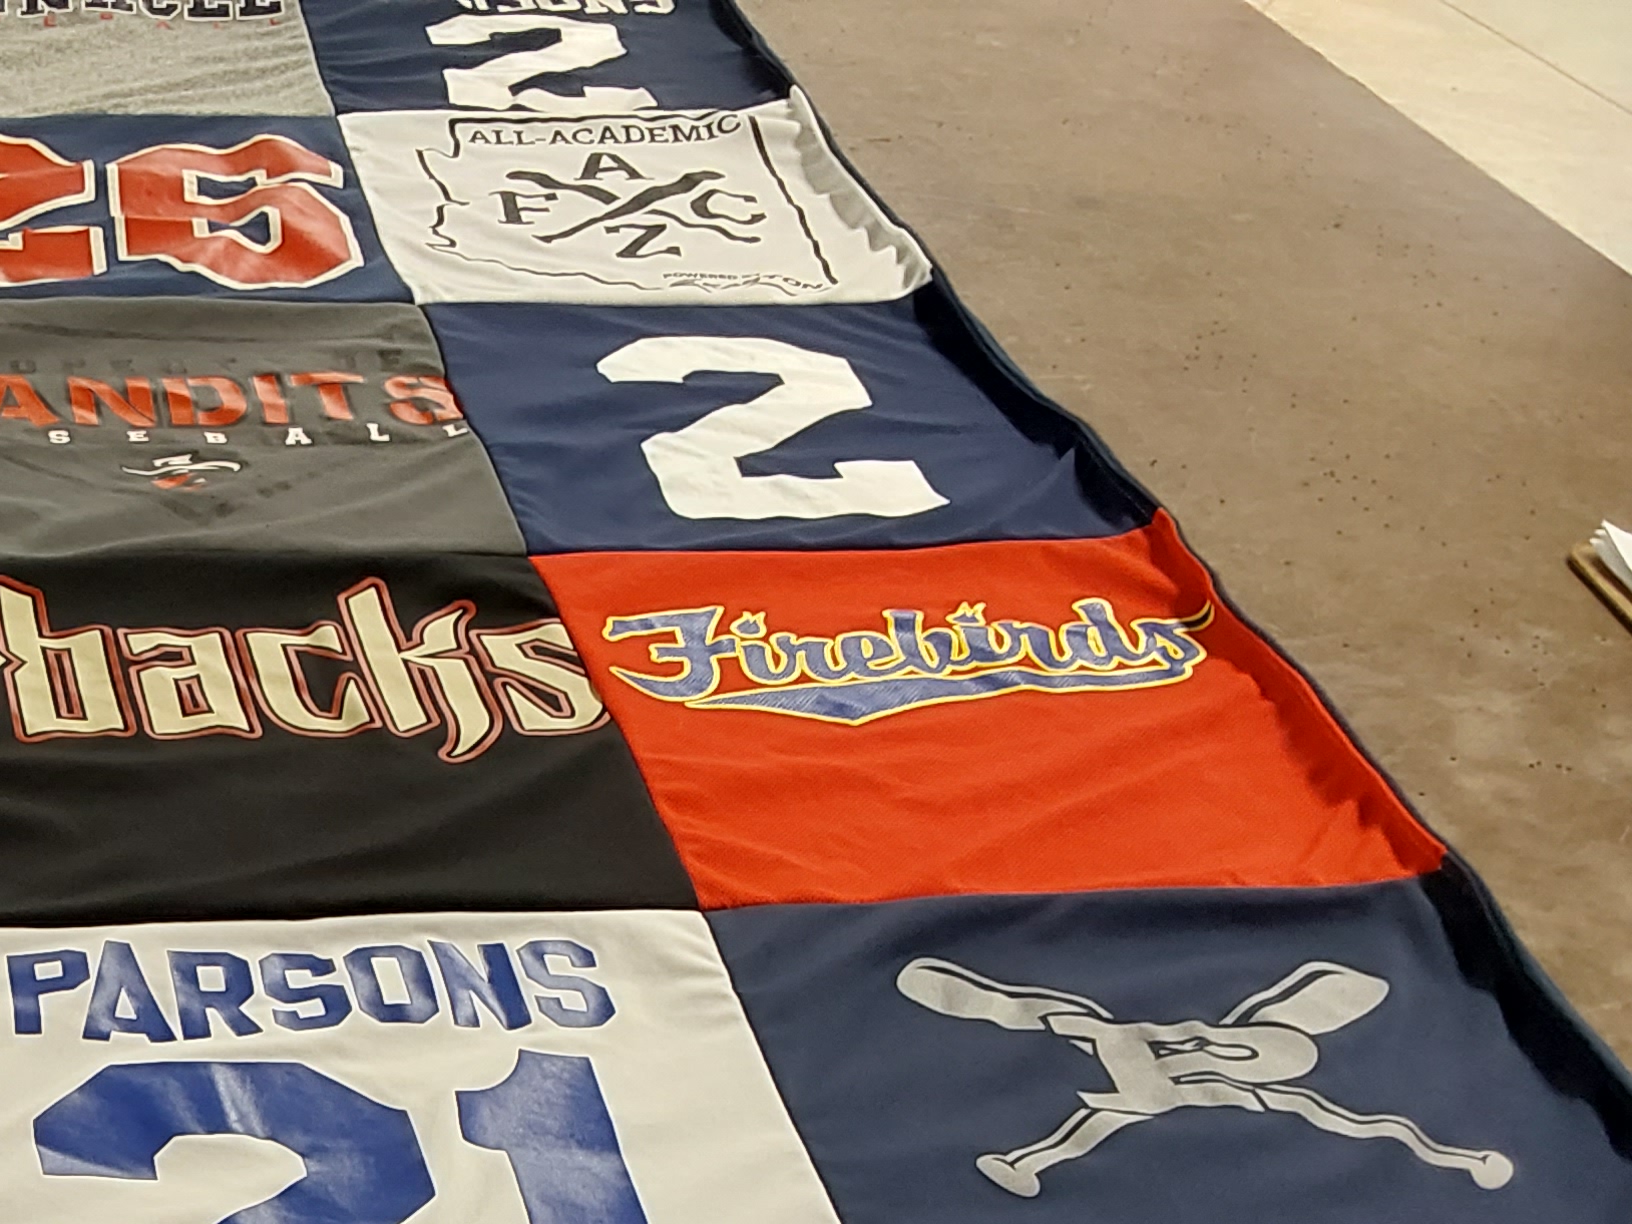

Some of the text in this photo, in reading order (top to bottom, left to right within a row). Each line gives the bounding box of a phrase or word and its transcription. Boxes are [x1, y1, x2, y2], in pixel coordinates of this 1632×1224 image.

[425, 13, 660, 113] 2
[467, 114, 742, 146] ALL-ACADEMIC
[573, 152, 656, 180] A
[488, 190, 559, 225] F
[690, 189, 767, 225] C
[604, 223, 682, 258] Z
[596, 336, 951, 520] 2
[604, 597, 1214, 702] Firebirds
[6, 939, 616, 1043] PARSONS
